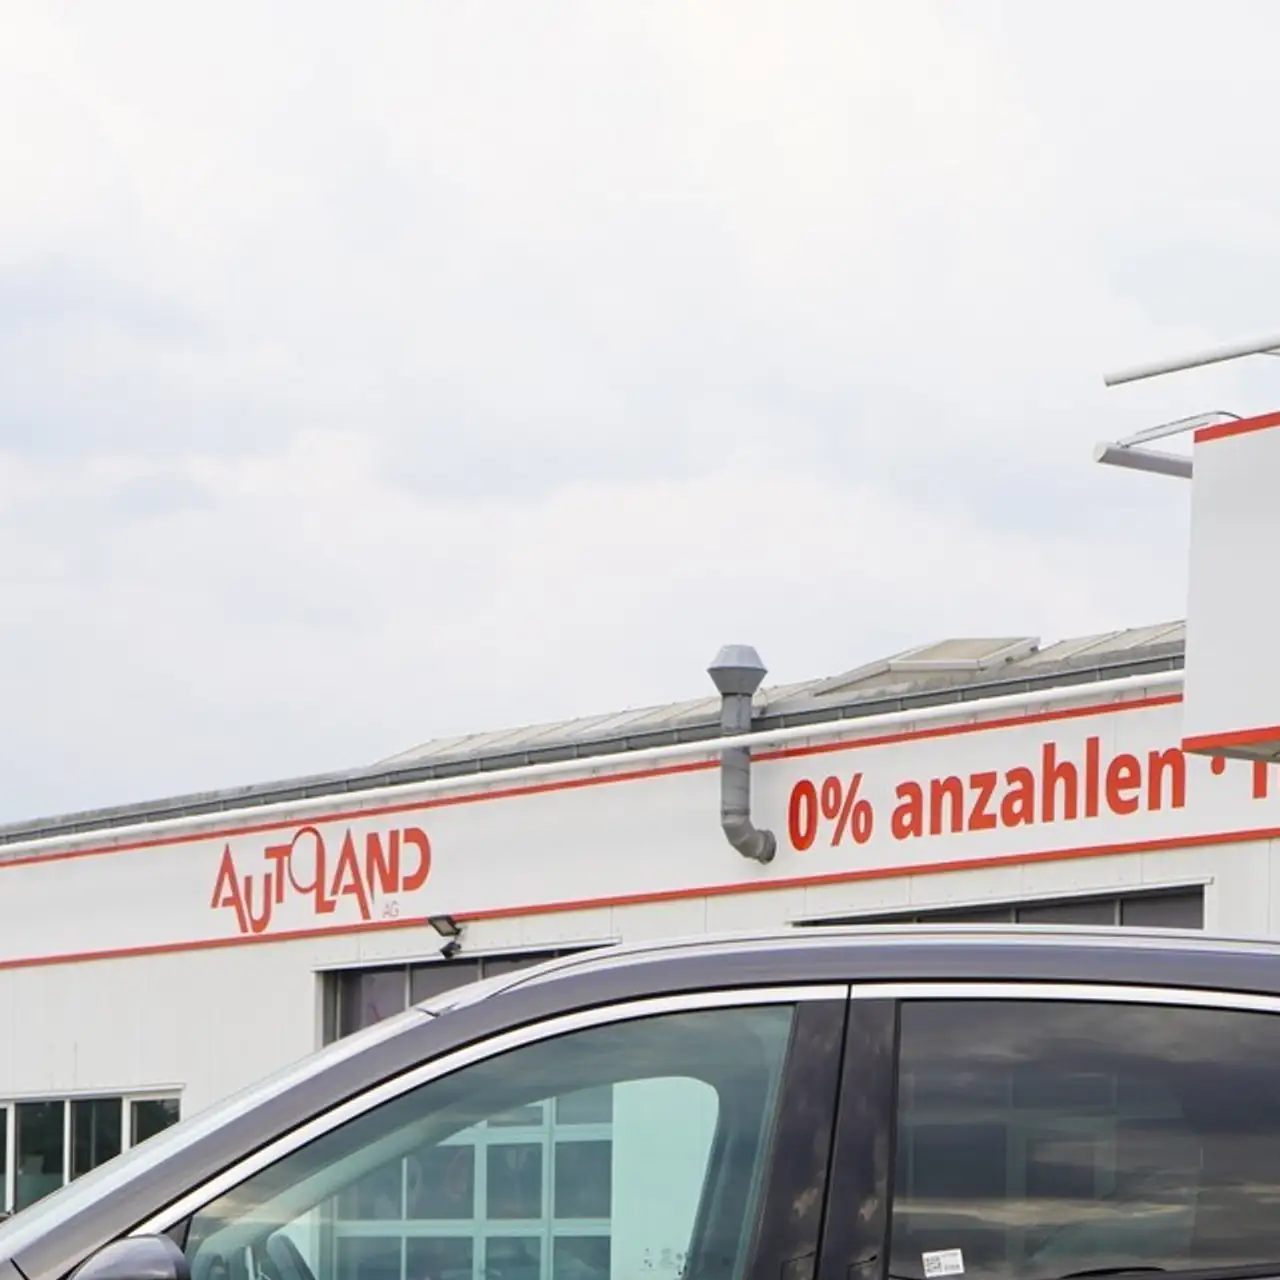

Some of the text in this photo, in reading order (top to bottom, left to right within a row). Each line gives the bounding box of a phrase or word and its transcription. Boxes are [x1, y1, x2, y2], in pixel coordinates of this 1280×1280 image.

[787, 771, 874, 853] 0%
[890, 736, 1186, 840] anzahlen
[210, 826, 433, 934] AUTOLAND
